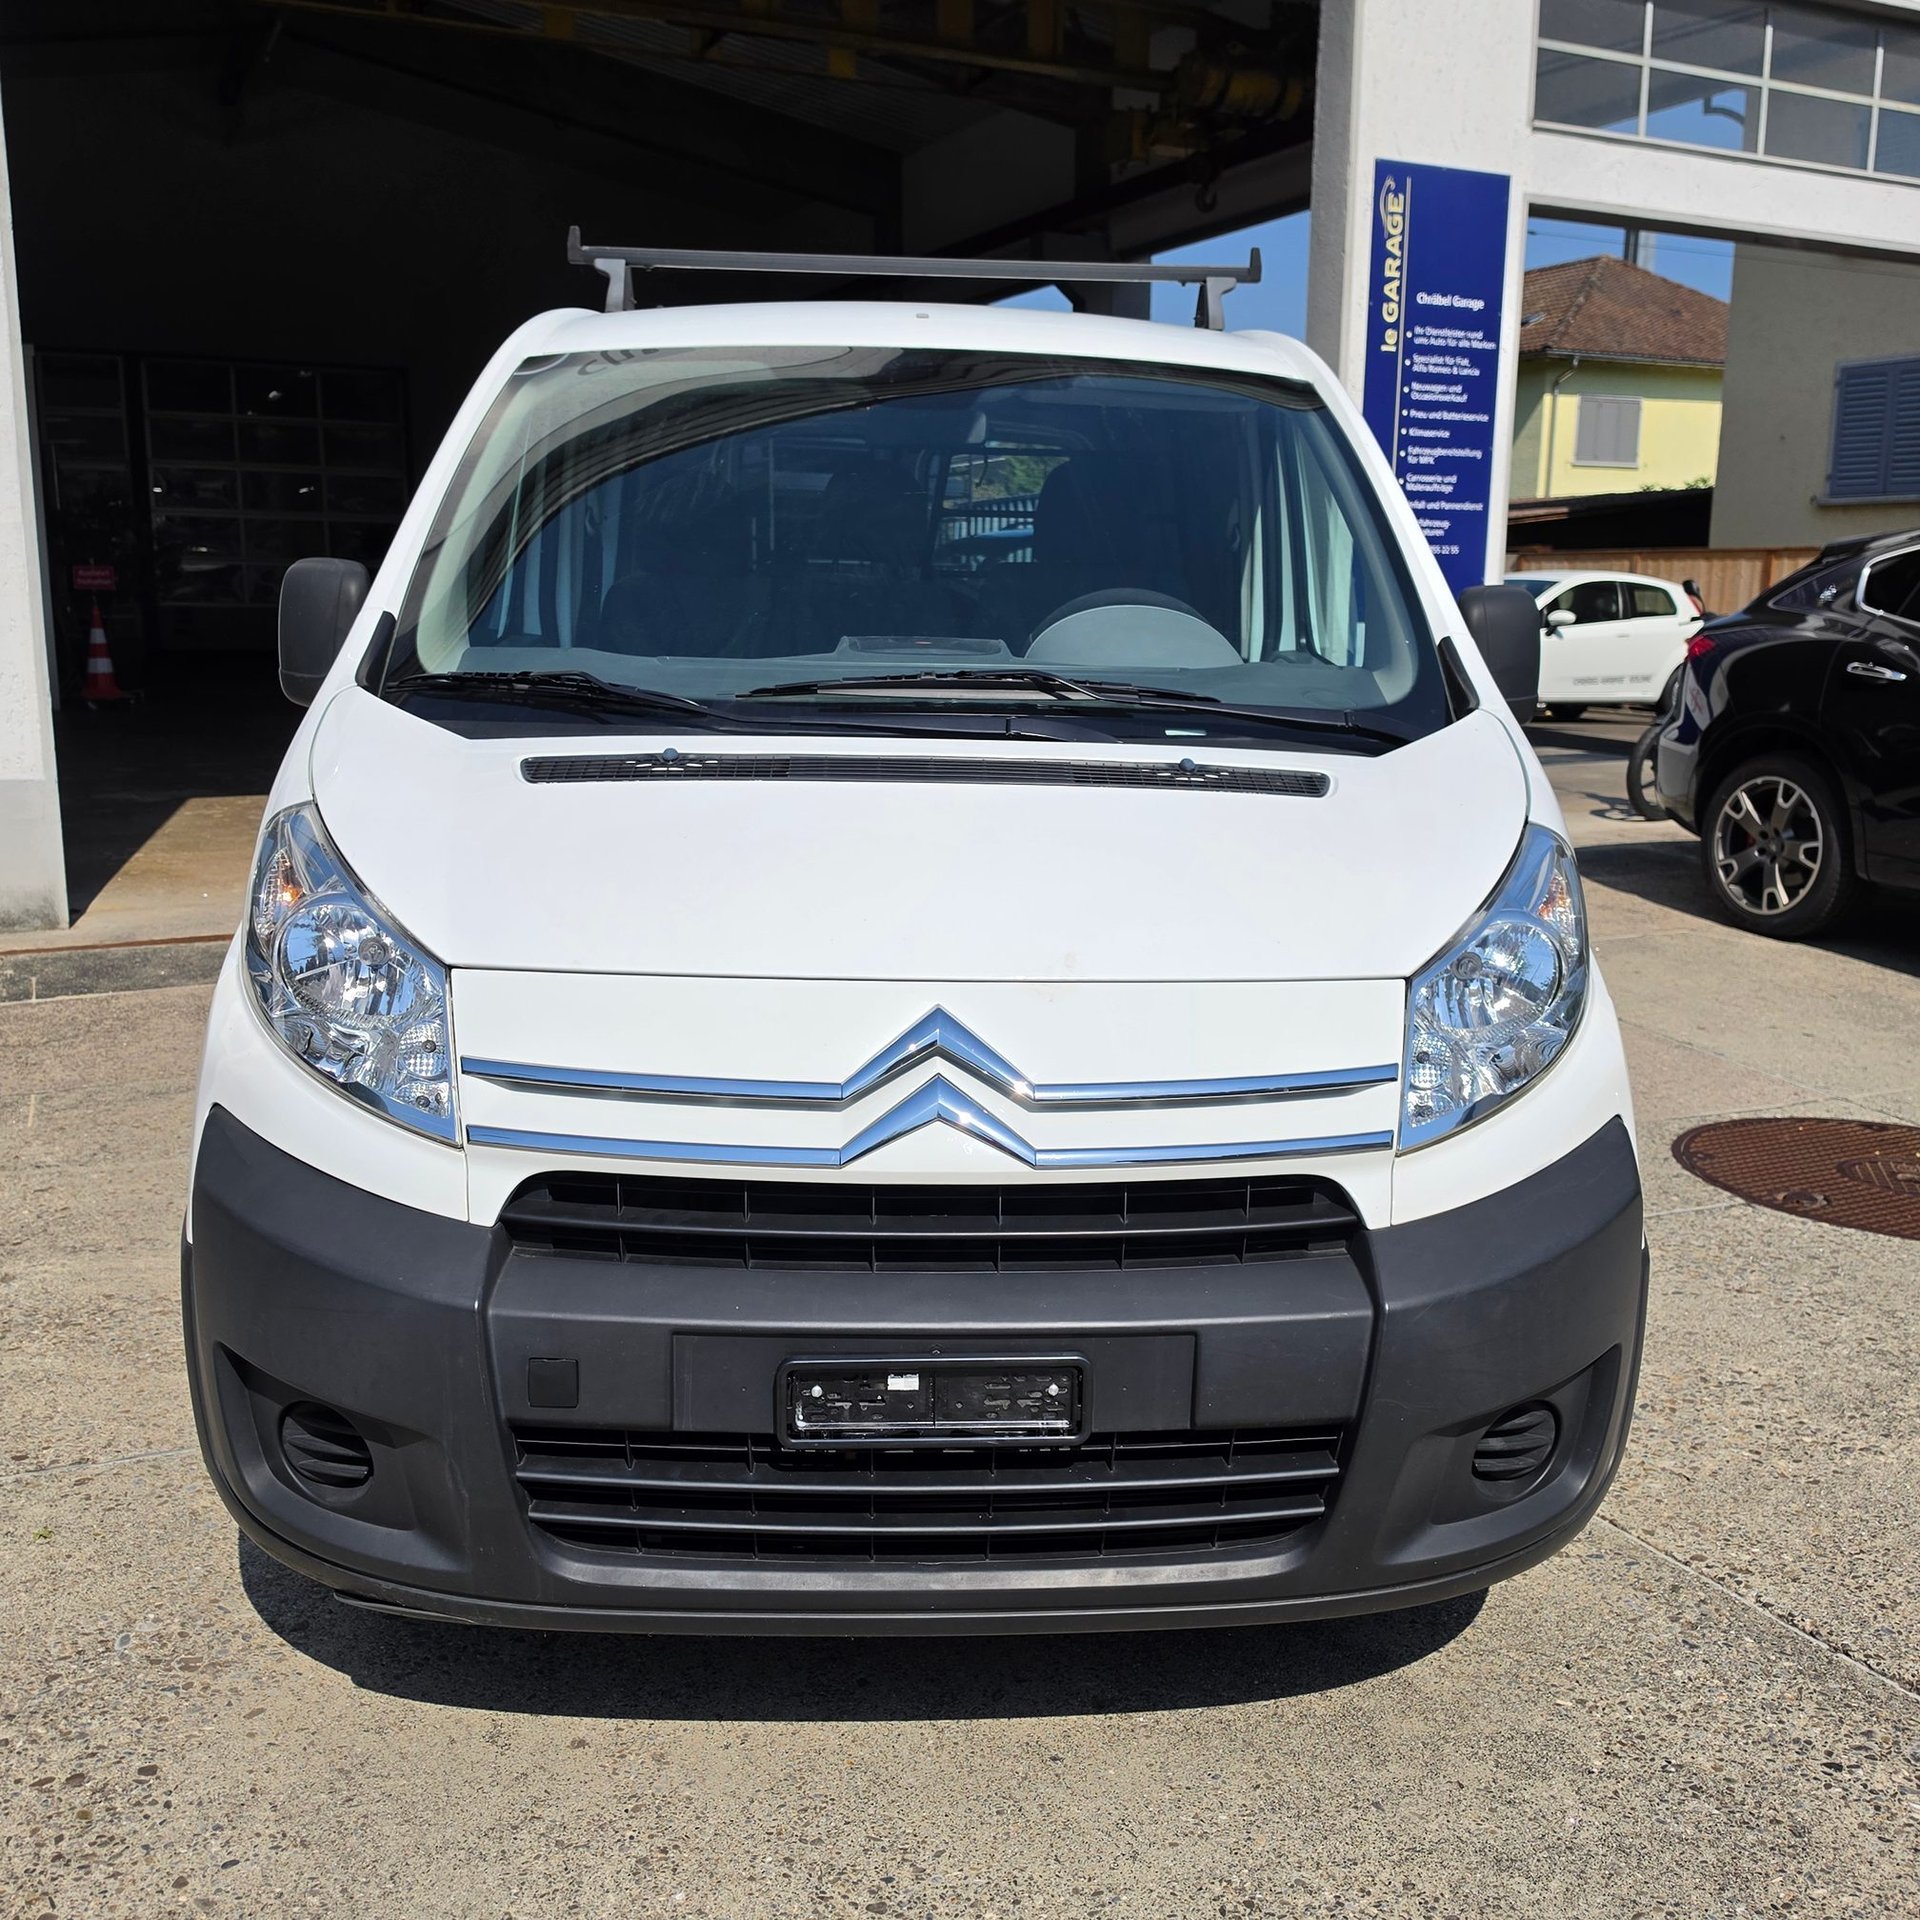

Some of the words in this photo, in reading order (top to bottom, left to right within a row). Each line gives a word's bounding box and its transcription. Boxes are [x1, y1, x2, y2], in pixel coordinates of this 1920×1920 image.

[1382, 191, 1405, 323] GARAGE
[1416, 292, 1452, 306] Chräbel
[1452, 295, 1485, 311] Garage
[1425, 326, 1466, 338] Dienstleister
[1380, 328, 1398, 352] le
[1429, 336, 1446, 347] Auto
[1446, 337, 1457, 347] für
[1458, 339, 1470, 348] alle
[1470, 339, 1496, 350] Marken
[1412, 353, 1444, 365] Spezialist
[1444, 355, 1455, 365] für
[1412, 363, 1428, 373] Alfa
[1428, 364, 1452, 375] Romeo
[1452, 366, 1458, 375] &
[1458, 366, 1480, 376] Lancia
[1411, 381, 1447, 394] Neuwagen
[1448, 384, 1463, 393] und
[1410, 391, 1468, 403] Occasionsverkauf
[1428, 411, 1442, 420] und
[1442, 410, 1489, 422] Batterieservice
[1408, 427, 1451, 438] Klimaservice
[1407, 445, 1483, 460] Fahrzeugbereitstellung
[1407, 455, 1418, 464] für
[1419, 455, 1435, 464] MFK
[1405, 472, 1443, 484] Carrosserie
[1443, 474, 1458, 484] und
[1408, 500, 1425, 510] nfall
[1426, 501, 1440, 510] und
[1440, 501, 1484, 511] Pannendienst
